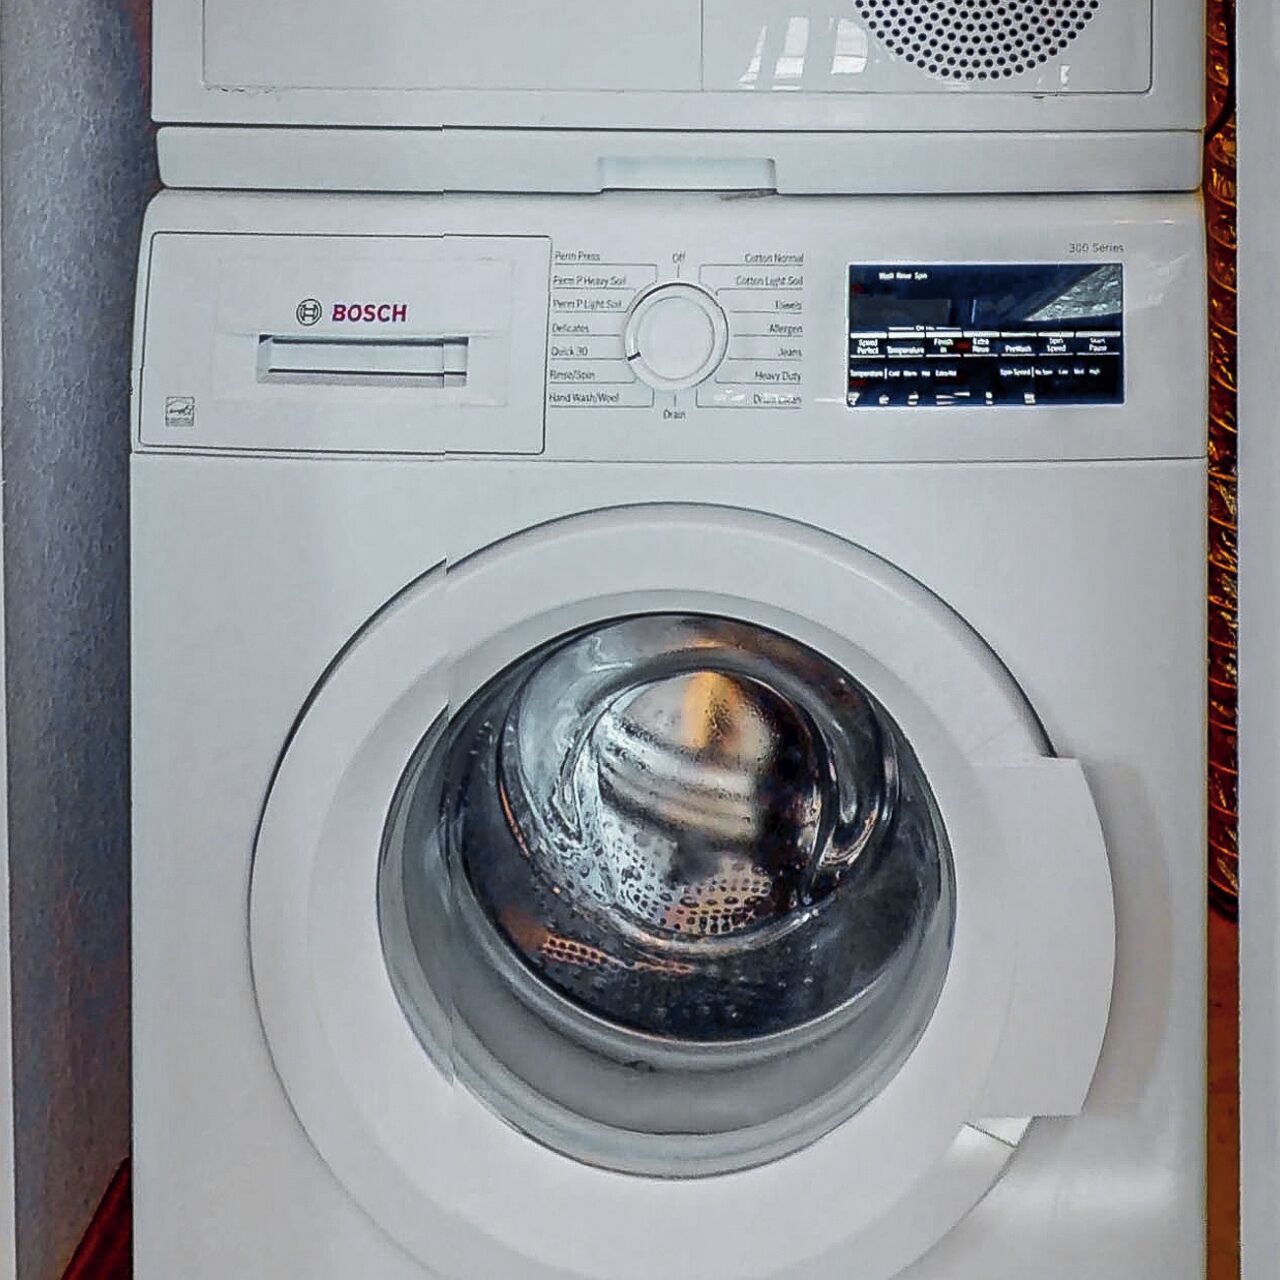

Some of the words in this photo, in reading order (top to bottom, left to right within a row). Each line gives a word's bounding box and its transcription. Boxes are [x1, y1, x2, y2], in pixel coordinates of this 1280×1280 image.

[1092, 242, 1125, 254] Series
[554, 250, 577, 260] Perm
[578, 251, 601, 261] Press
[744, 253, 773, 264] Cotton
[774, 253, 804, 264] Normal
[583, 276, 609, 288] Heavy
[609, 275, 627, 285] Soil
[736, 275, 765, 286] Cotton
[787, 276, 804, 286] Soil
[553, 299, 575, 309] Perm
[576, 299, 583, 309] P
[584, 300, 606, 311] Light
[606, 299, 622, 309] Soil
[332, 304, 408, 322] BOSCH
[552, 324, 590, 333] Delicates
[769, 324, 803, 335] Allergen
[551, 346, 575, 356] Quick
[754, 371, 781, 382] Heavy
[782, 371, 802, 382] Duty
[548, 393, 571, 403] Hand
[662, 409, 687, 420] Drain
